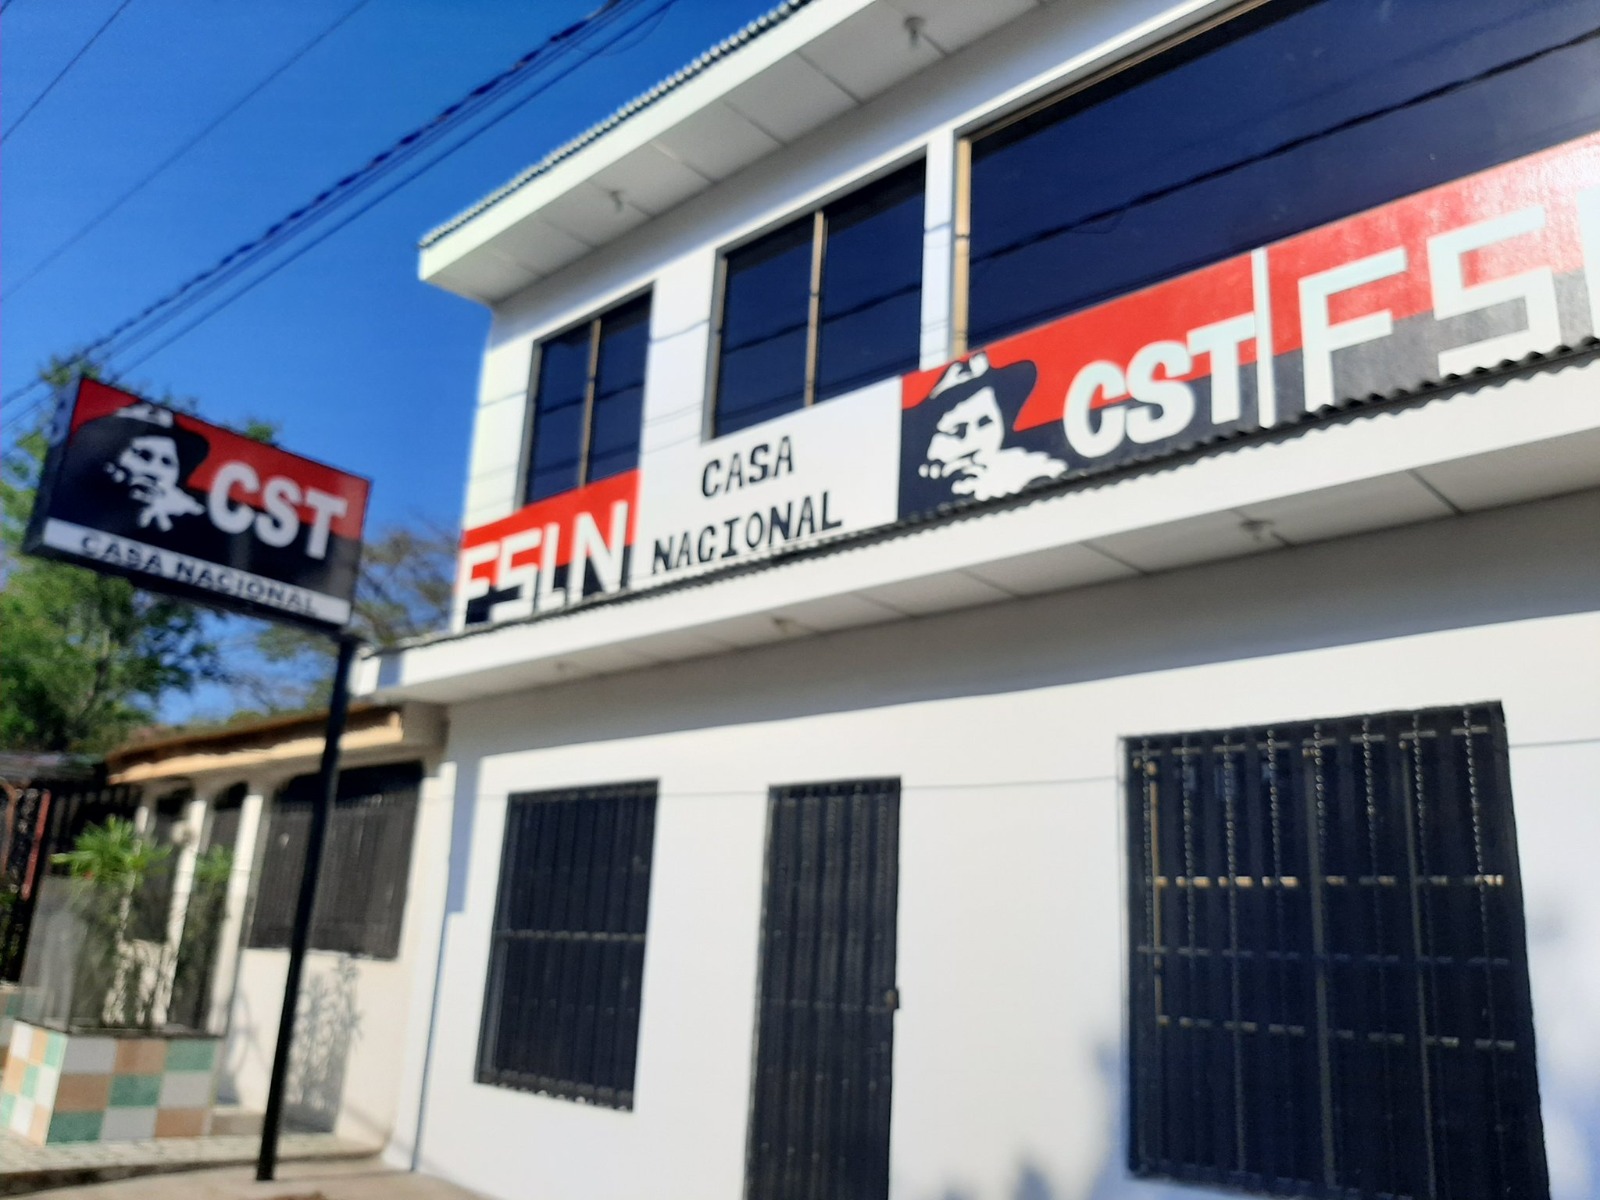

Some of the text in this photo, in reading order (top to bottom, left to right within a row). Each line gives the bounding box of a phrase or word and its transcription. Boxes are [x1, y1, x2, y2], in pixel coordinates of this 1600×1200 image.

[1299, 184, 1600, 412] FS
[1063, 312, 1255, 457] CST
[208, 461, 348, 560] CST
[702, 435, 794, 498] CASA
[82, 536, 316, 616] CASA NACIONAL
[452, 500, 628, 634] FSLN
[652, 492, 843, 574] NACIONAL
